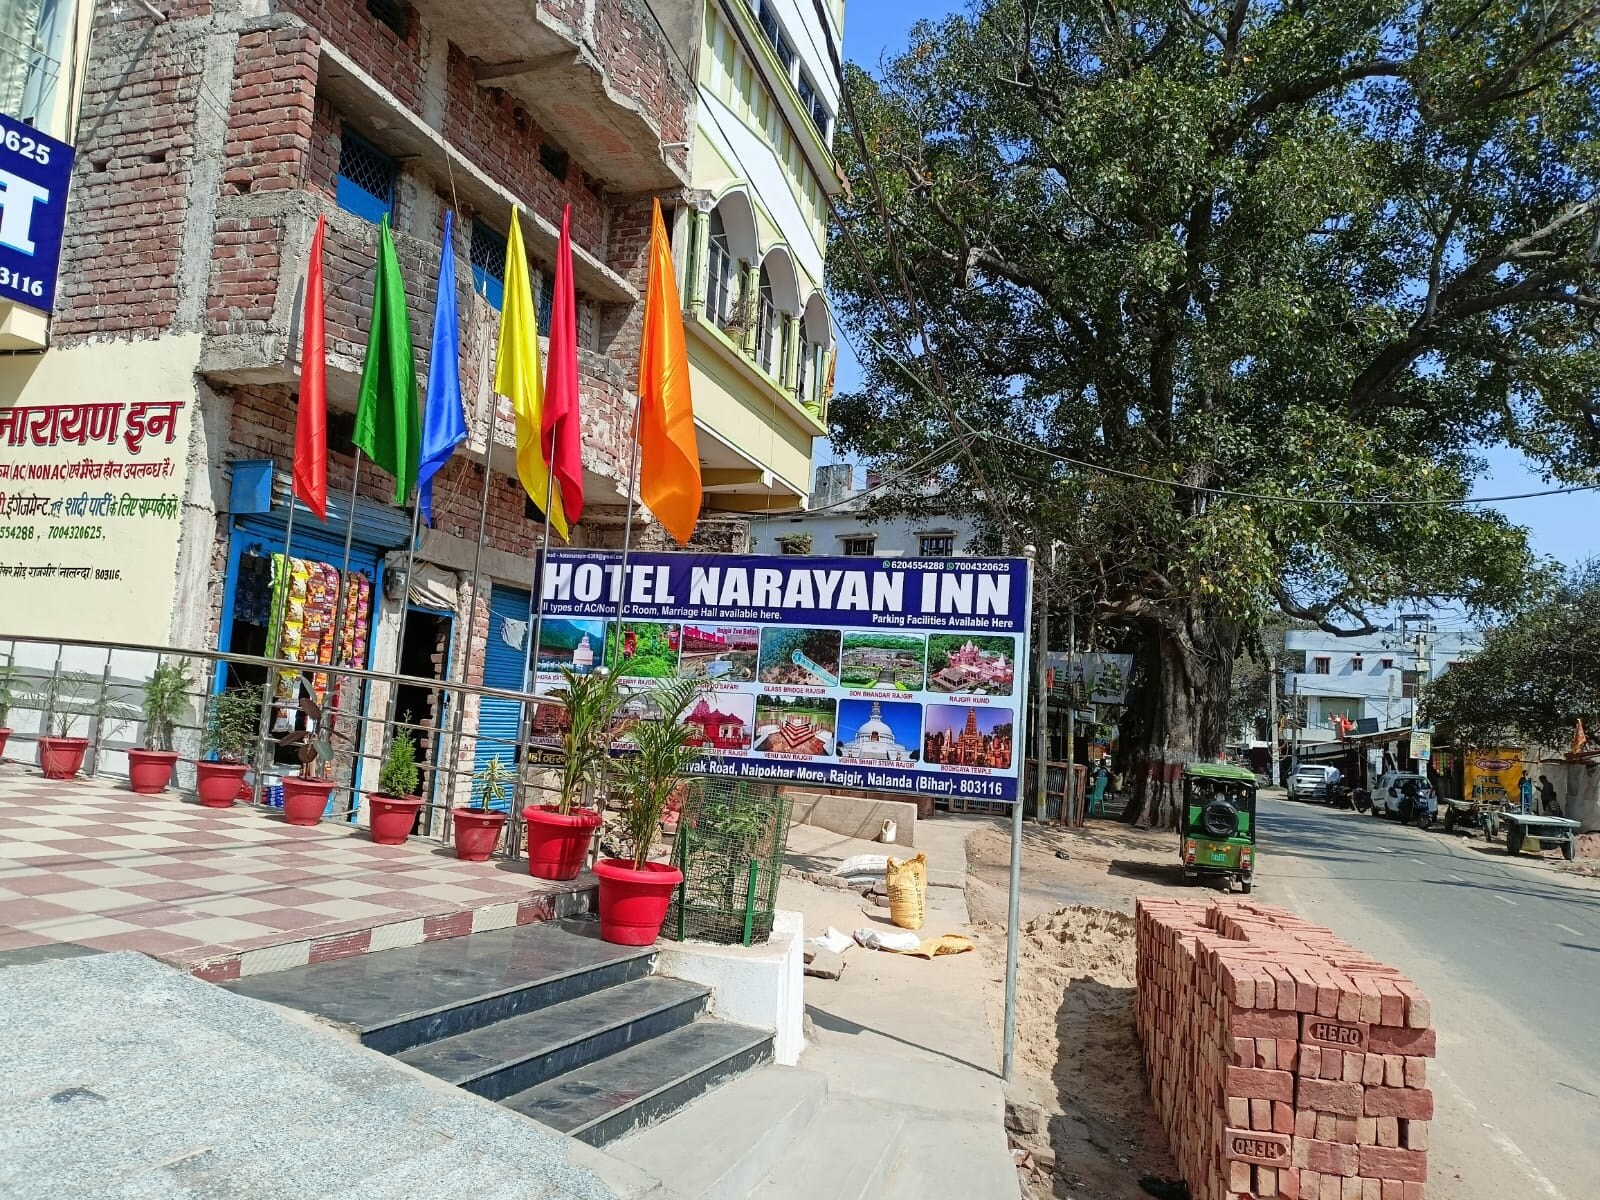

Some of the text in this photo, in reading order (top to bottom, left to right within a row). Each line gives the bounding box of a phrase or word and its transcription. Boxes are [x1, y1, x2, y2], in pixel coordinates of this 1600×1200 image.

[124, 401, 183, 454] इन
[65, 492, 89, 517] शादी
[89, 492, 113, 517] पार्टी
[118, 492, 139, 517] लिए
[891, 561, 1009, 571] 6204554288 7004320625
[543, 563, 1011, 616] HOTEL NARAYAN INN
[551, 604, 572, 613] types
[574, 604, 582, 612] of
[584, 605, 615, 614] AC/Non
[632, 606, 659, 617] Room,
[661, 606, 698, 618] Marriage
[701, 608, 717, 617] Hall
[720, 609, 757, 618] available
[760, 611, 782, 620] here.
[872, 614, 1013, 628] Parking Facilities Available Here
[709, 761, 738, 776] Road,
[741, 762, 795, 779] Naipokhar
[797, 768, 826, 783] More,
[830, 769, 863, 787] Rajgir,
[868, 773, 913, 787] Nalanda
[960, 780, 1002, 795] 803116
[1316, 1024, 1360, 1043] HERO
[1235, 1139, 1278, 1159] HERO
